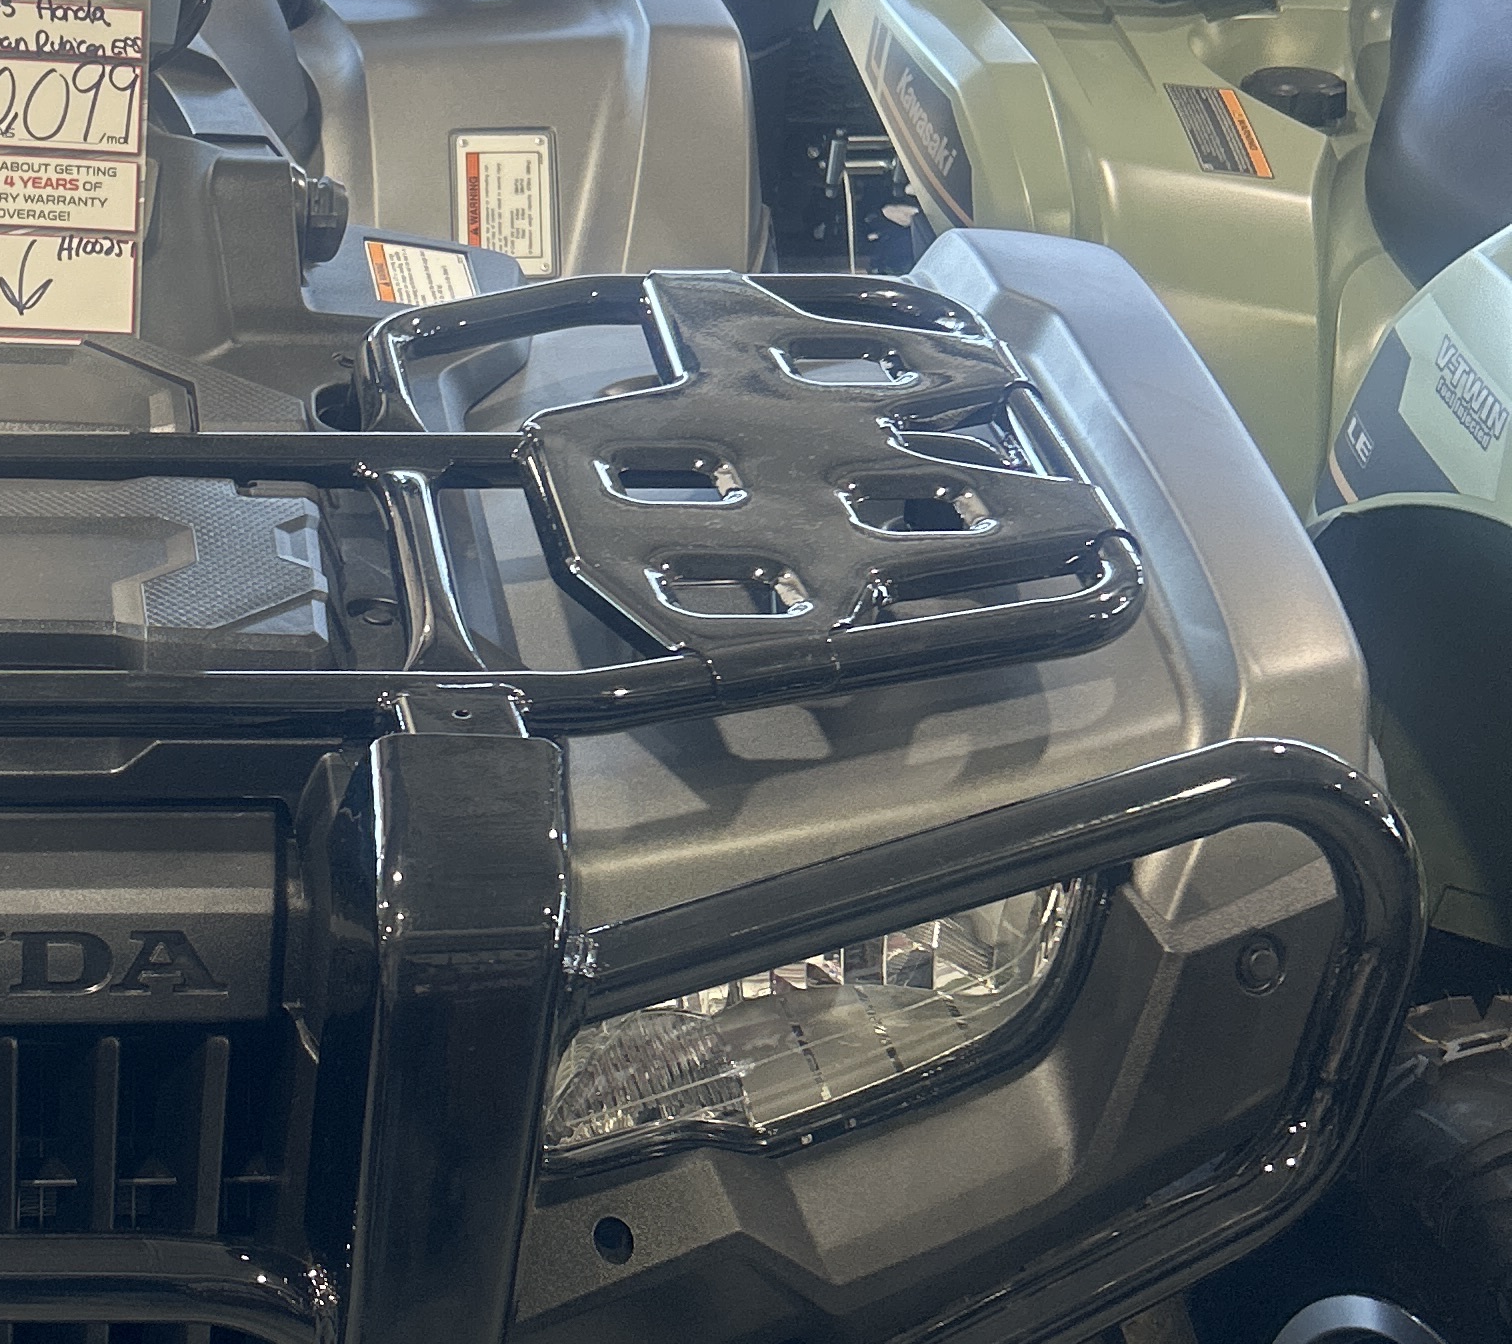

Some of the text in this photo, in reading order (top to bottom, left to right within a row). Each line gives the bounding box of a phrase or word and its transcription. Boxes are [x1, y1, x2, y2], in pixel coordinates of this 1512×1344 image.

[35, 29, 106, 57] Rubicon
[110, 35, 143, 58] EPS
[896, 66, 958, 177] Kawasaki
[0, 161, 51, 174] ABOUT
[54, 164, 118, 178] GETTING
[3, 175, 16, 188] 4
[19, 176, 79, 191] YEARS
[82, 181, 103, 192] OF
[23, 194, 108, 208] WARRANTY
[468, 175, 480, 226] WARNING
[1435, 333, 1510, 441] V-TWIN
[1436, 375, 1458, 410] fuel
[1347, 416, 1374, 463] LE
